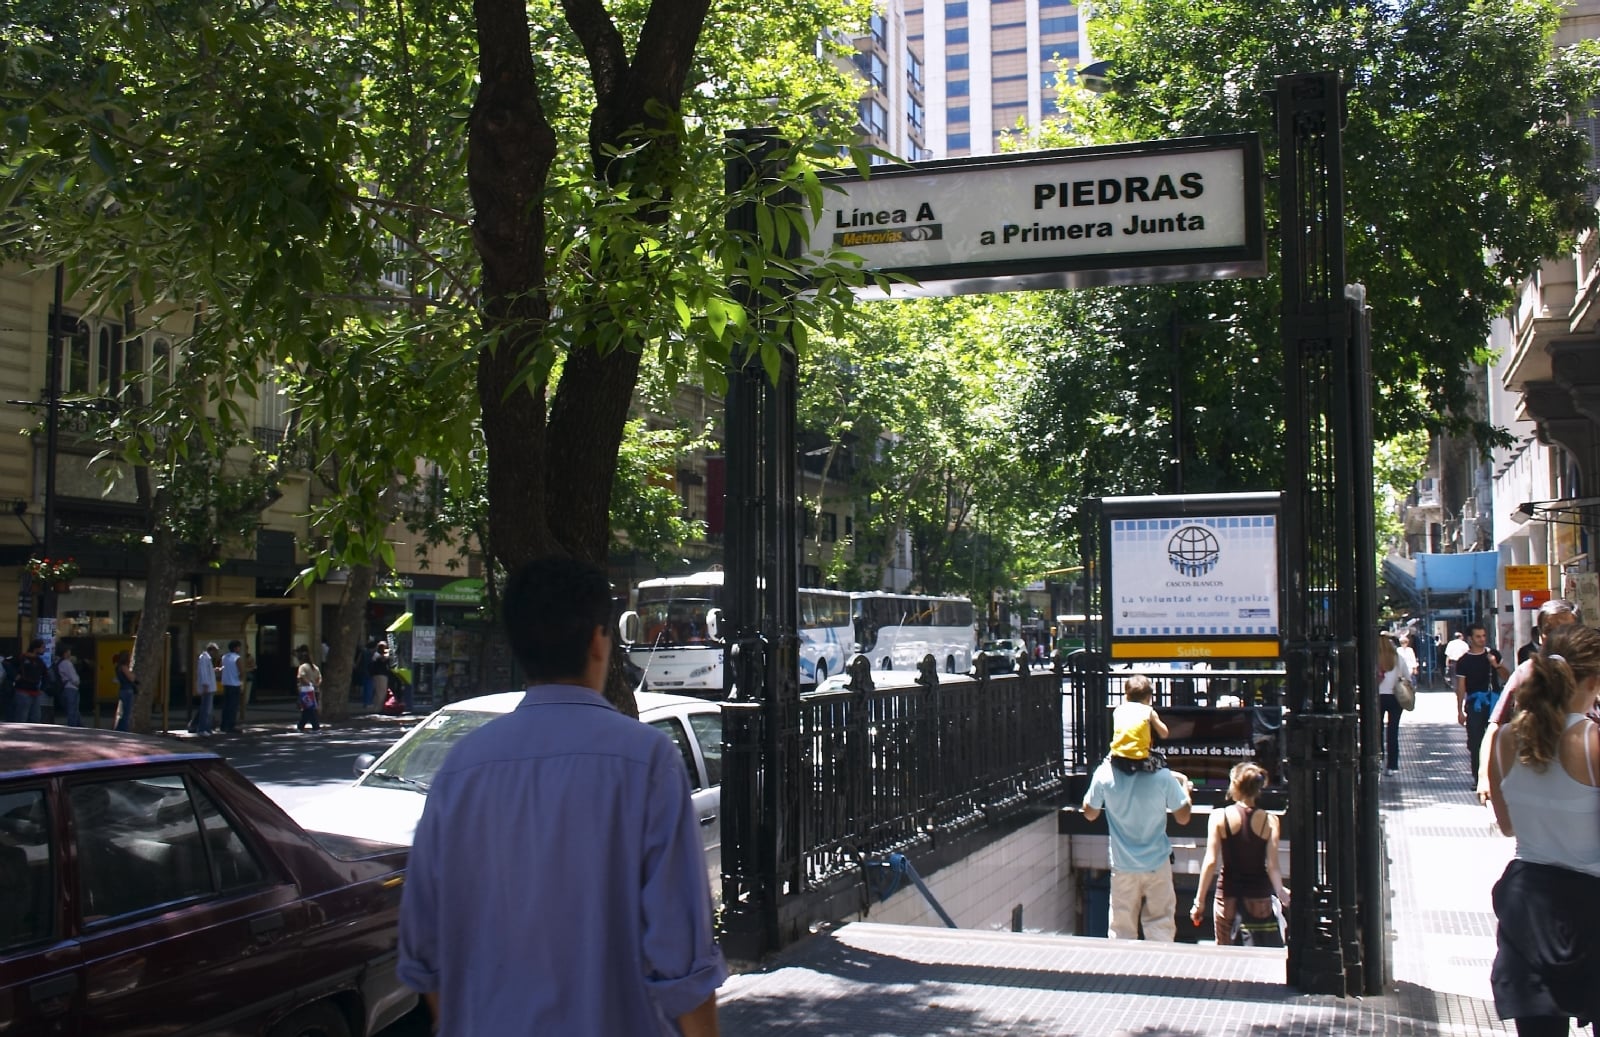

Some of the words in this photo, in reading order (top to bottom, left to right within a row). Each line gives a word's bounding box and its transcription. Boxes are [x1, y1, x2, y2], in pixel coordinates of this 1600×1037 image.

[1034, 172, 1204, 209] PIEDRAS
[836, 208, 907, 228] Línea
[916, 202, 935, 222] A
[980, 228, 996, 246] a
[1003, 222, 1113, 244] Primera
[1123, 214, 1205, 235] Junta
[1121, 595, 1134, 604] La
[1139, 595, 1192, 603] Voluntad
[1215, 594, 1270, 604] Organiza
[1177, 646, 1212, 657] Subte
[1168, 746, 1179, 755] de
[1181, 746, 1190, 755] la
[1192, 746, 1208, 755] red
[1210, 746, 1222, 755] de
[1224, 746, 1256, 756] Subtes
